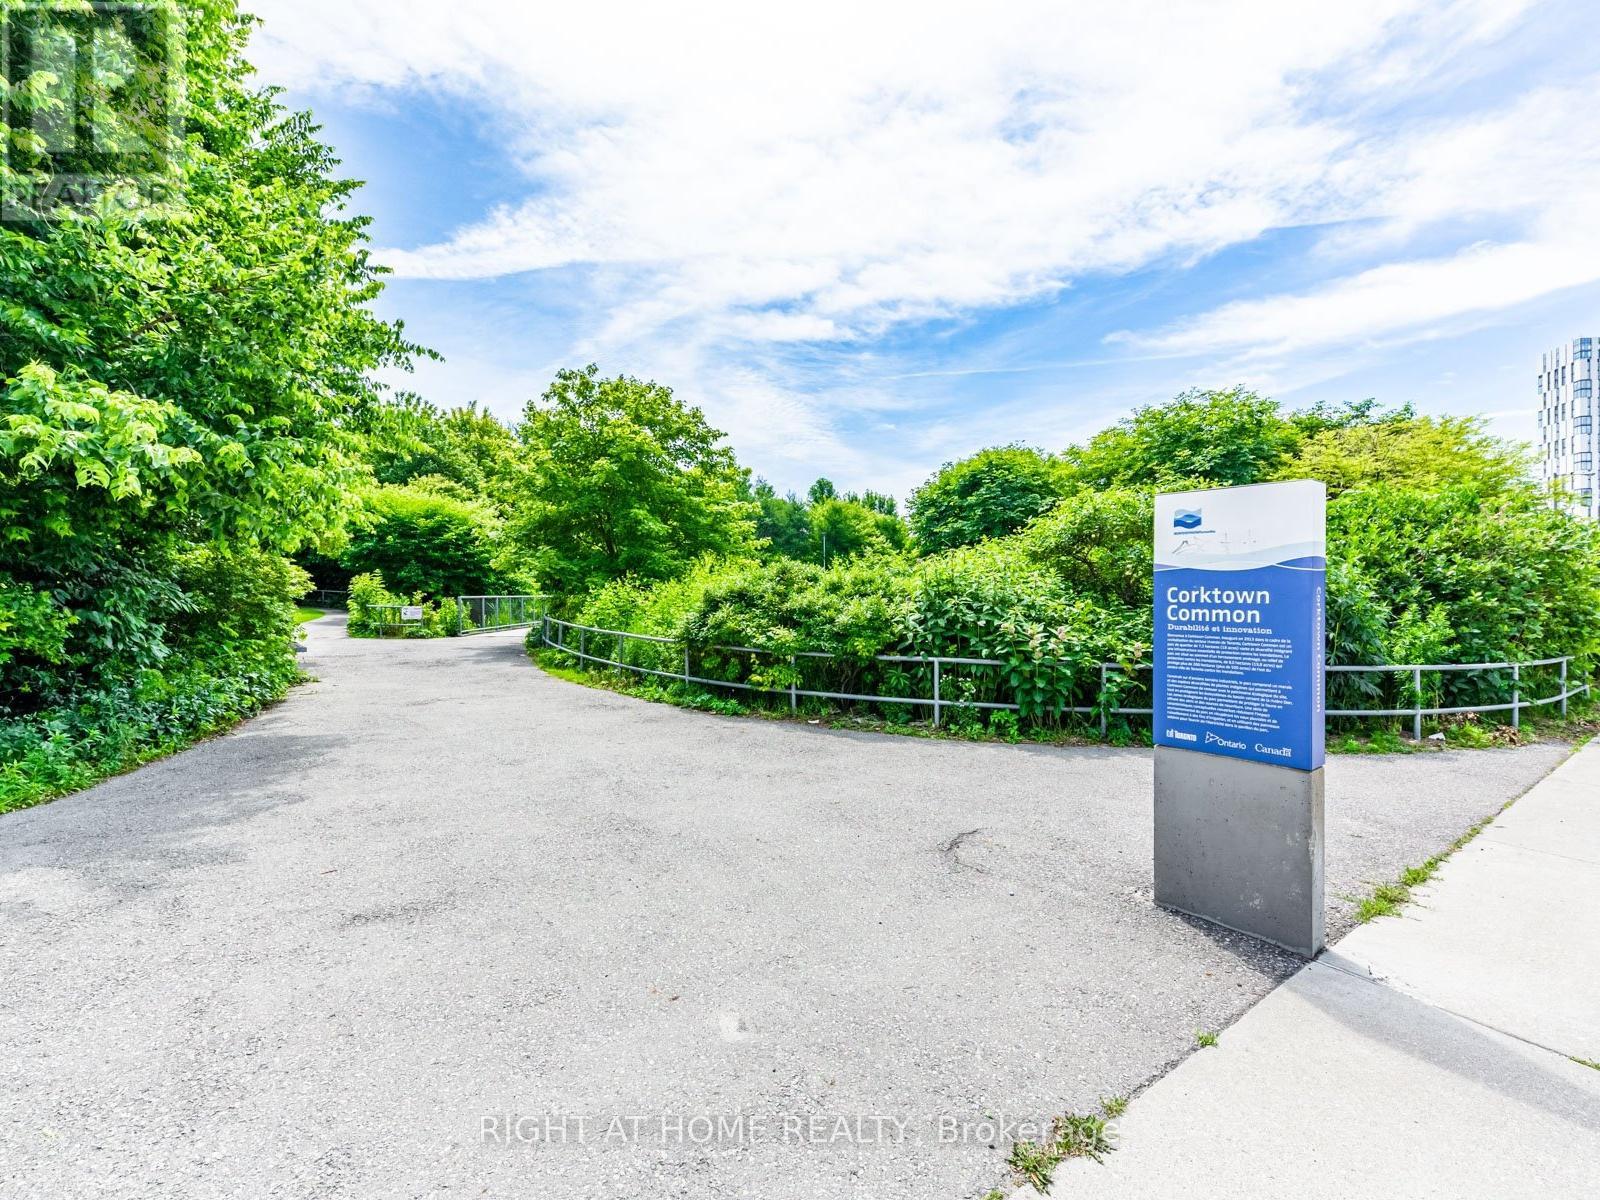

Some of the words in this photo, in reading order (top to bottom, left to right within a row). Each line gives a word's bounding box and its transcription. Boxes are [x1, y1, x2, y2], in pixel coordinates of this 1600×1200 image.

[1167, 586, 1270, 604] Corktown
[1167, 605, 1260, 623] Common
[1167, 623, 1209, 632] Durabilité
[1223, 625, 1272, 634] innovation
[1217, 738, 1247, 750] Ontario
[1255, 743, 1291, 757] Canada
